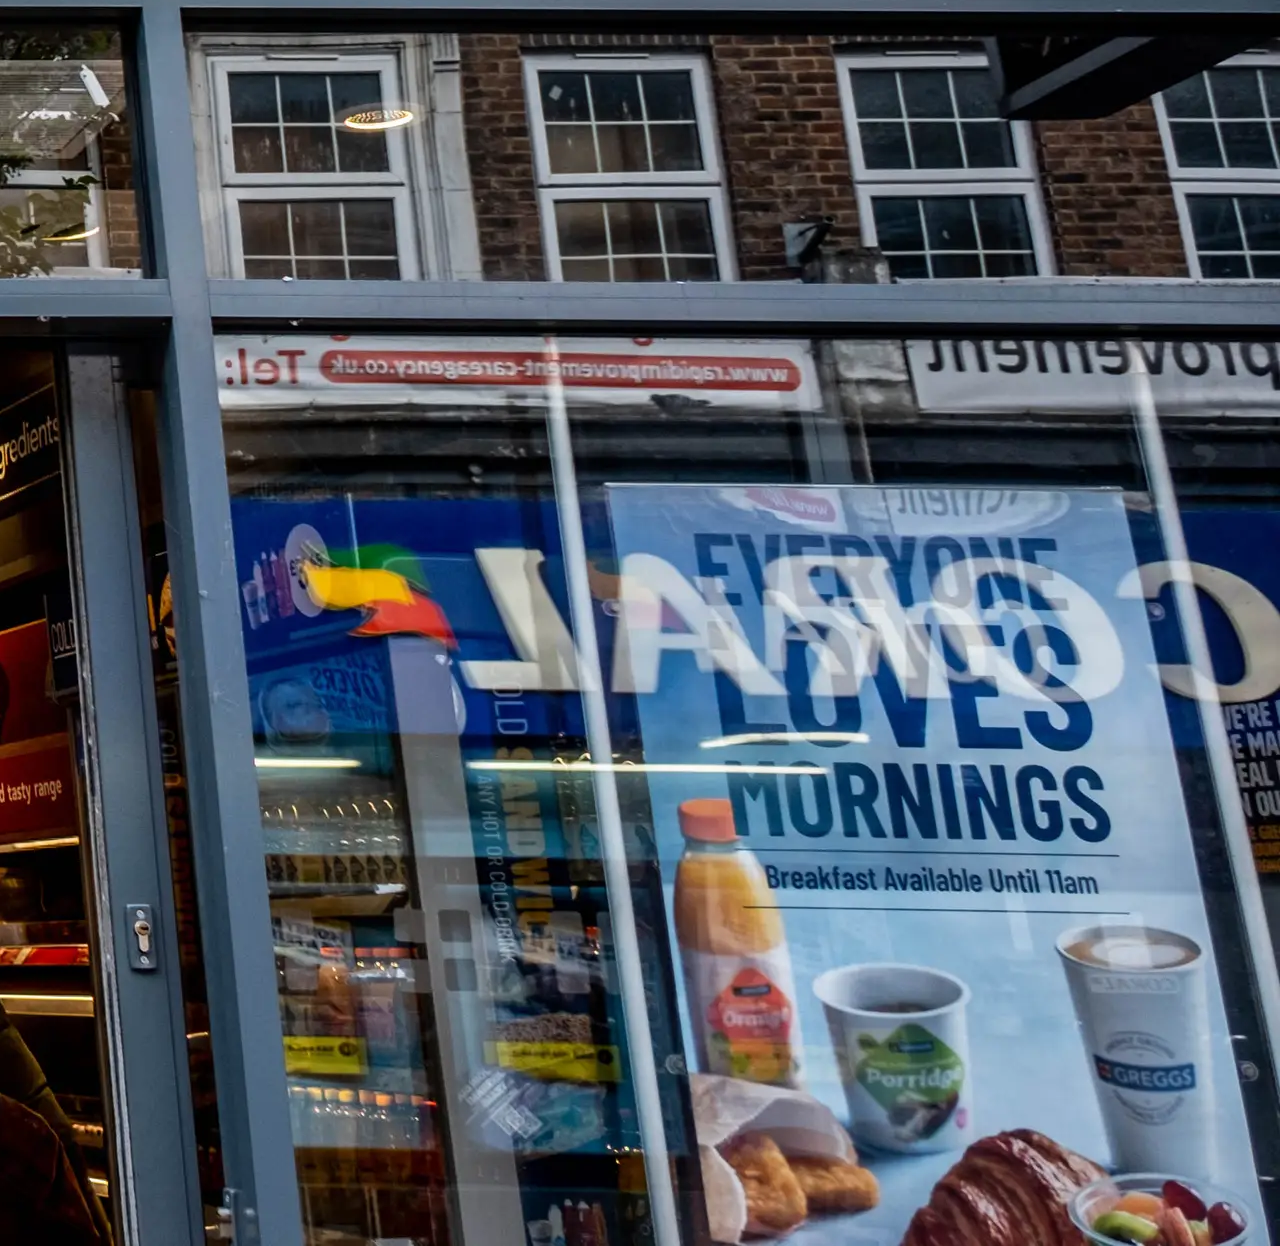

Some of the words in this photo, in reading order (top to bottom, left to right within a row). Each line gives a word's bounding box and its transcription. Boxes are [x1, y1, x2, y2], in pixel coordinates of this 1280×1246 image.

[693, 532, 1070, 612] EVERYONE
[491, 666, 528, 734] OLD
[706, 620, 1095, 752] LOVES
[1246, 730, 1280, 758] MA
[7, 780, 32, 808] tasty
[34, 778, 62, 803] range
[477, 775, 492, 805] ANY
[722, 762, 1112, 844] MORNINGS
[481, 810, 501, 840] HOT
[486, 845, 504, 866] OR
[490, 871, 511, 915] COLD
[766, 864, 878, 892] Breakfast
[884, 866, 983, 893] Available
[989, 868, 1041, 894] Until
[1047, 869, 1100, 896] 11am
[1114, 1066, 1193, 1089] GREGGS
